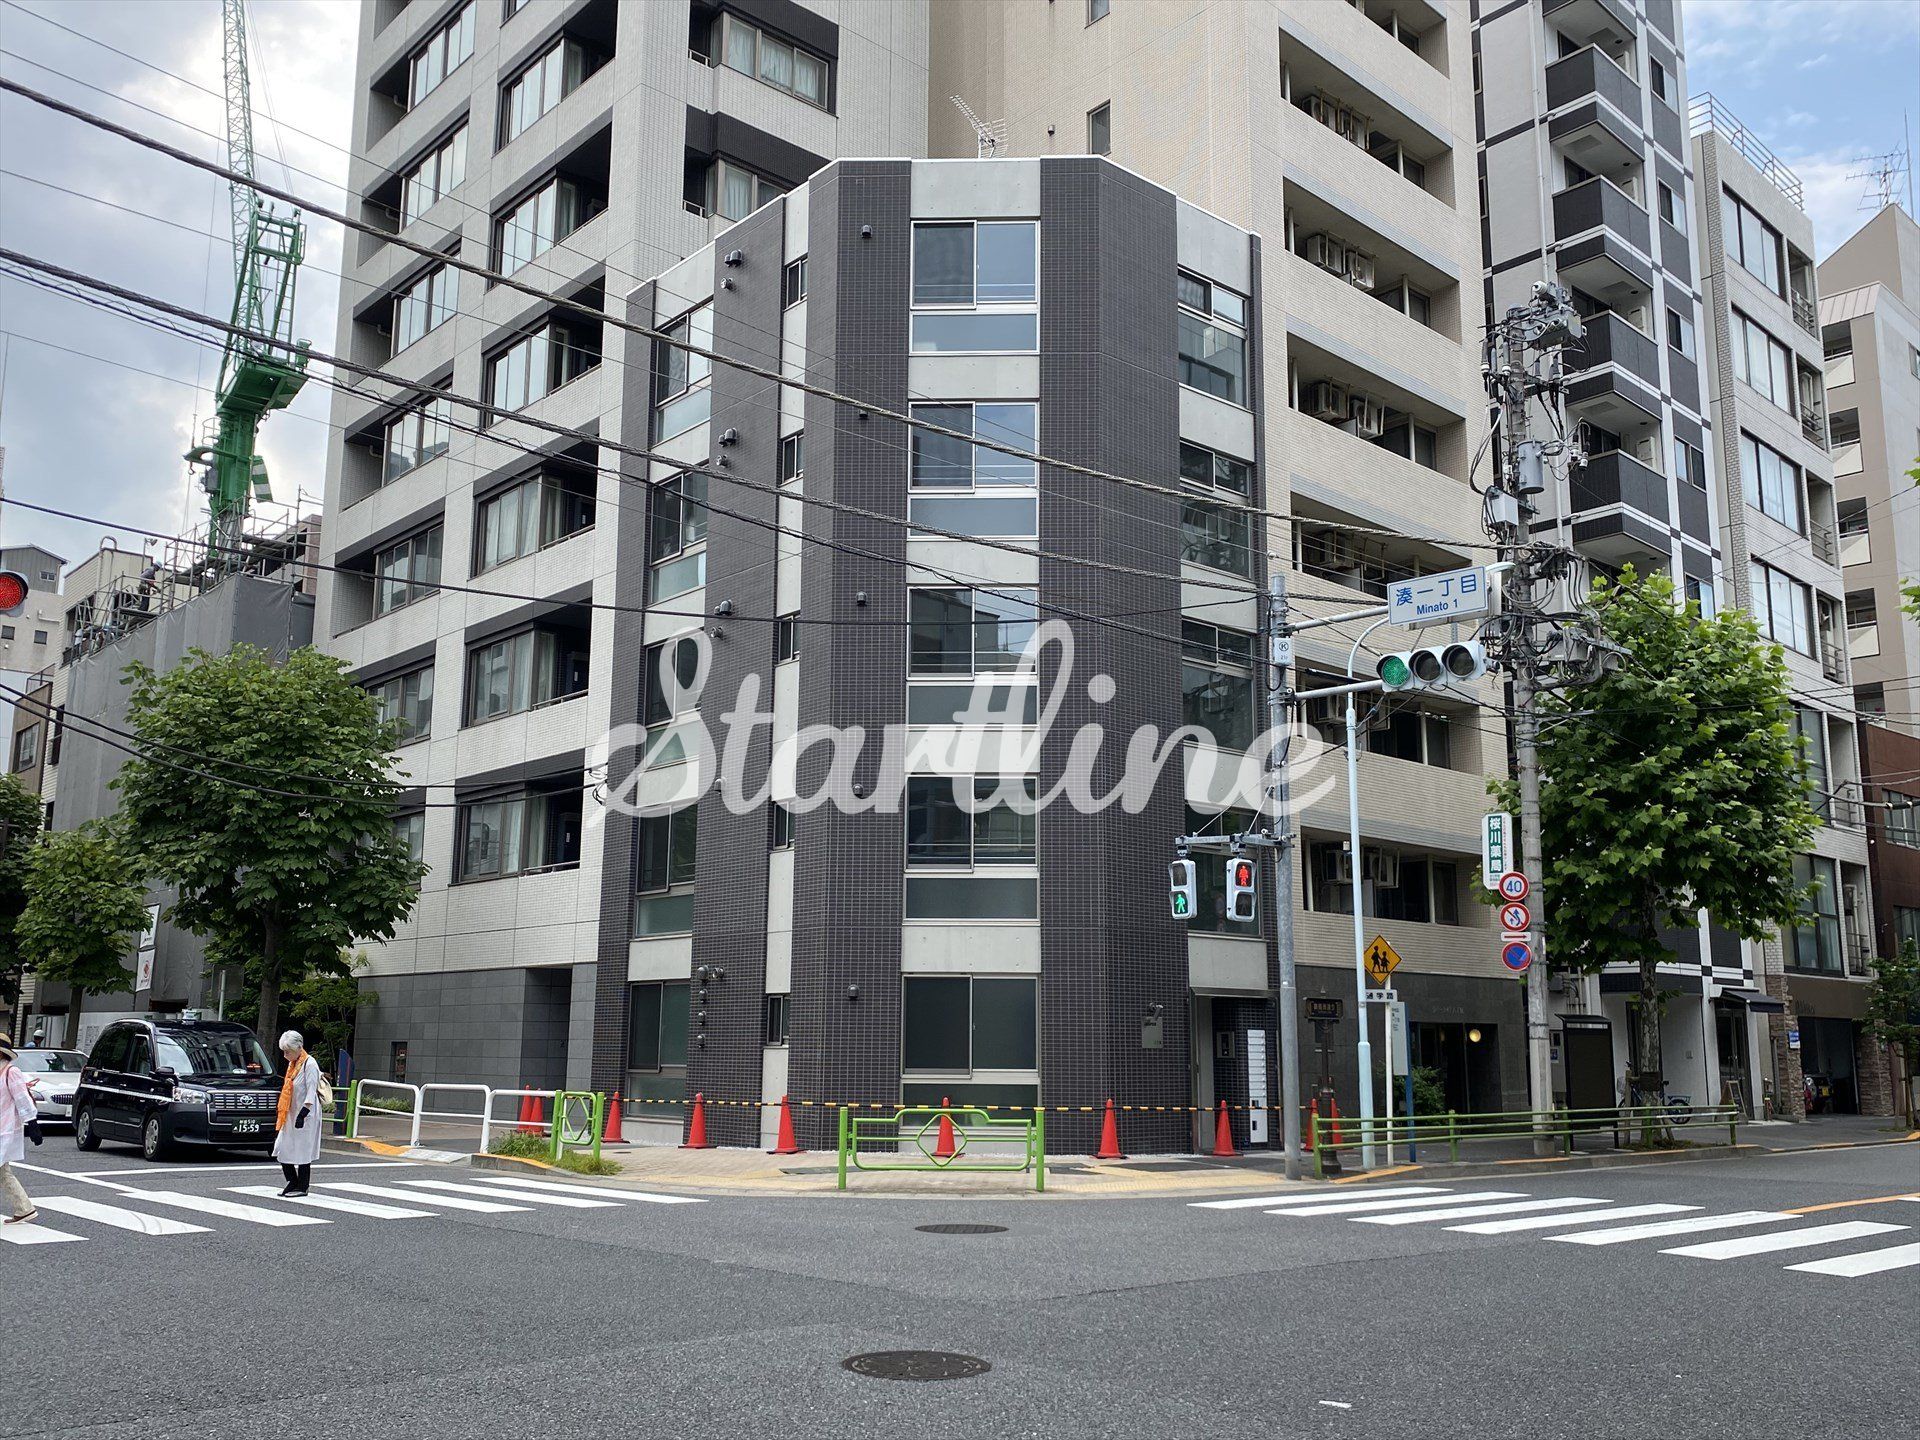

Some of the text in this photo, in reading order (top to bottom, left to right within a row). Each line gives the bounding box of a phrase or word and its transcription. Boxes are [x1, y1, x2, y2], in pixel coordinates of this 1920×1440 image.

[1396, 574, 1477, 606] 湊一丁目
[1416, 599, 1458, 615] Minato 1
[1490, 817, 1502, 871] 桜川薬局
[1506, 881, 1522, 893] 40
